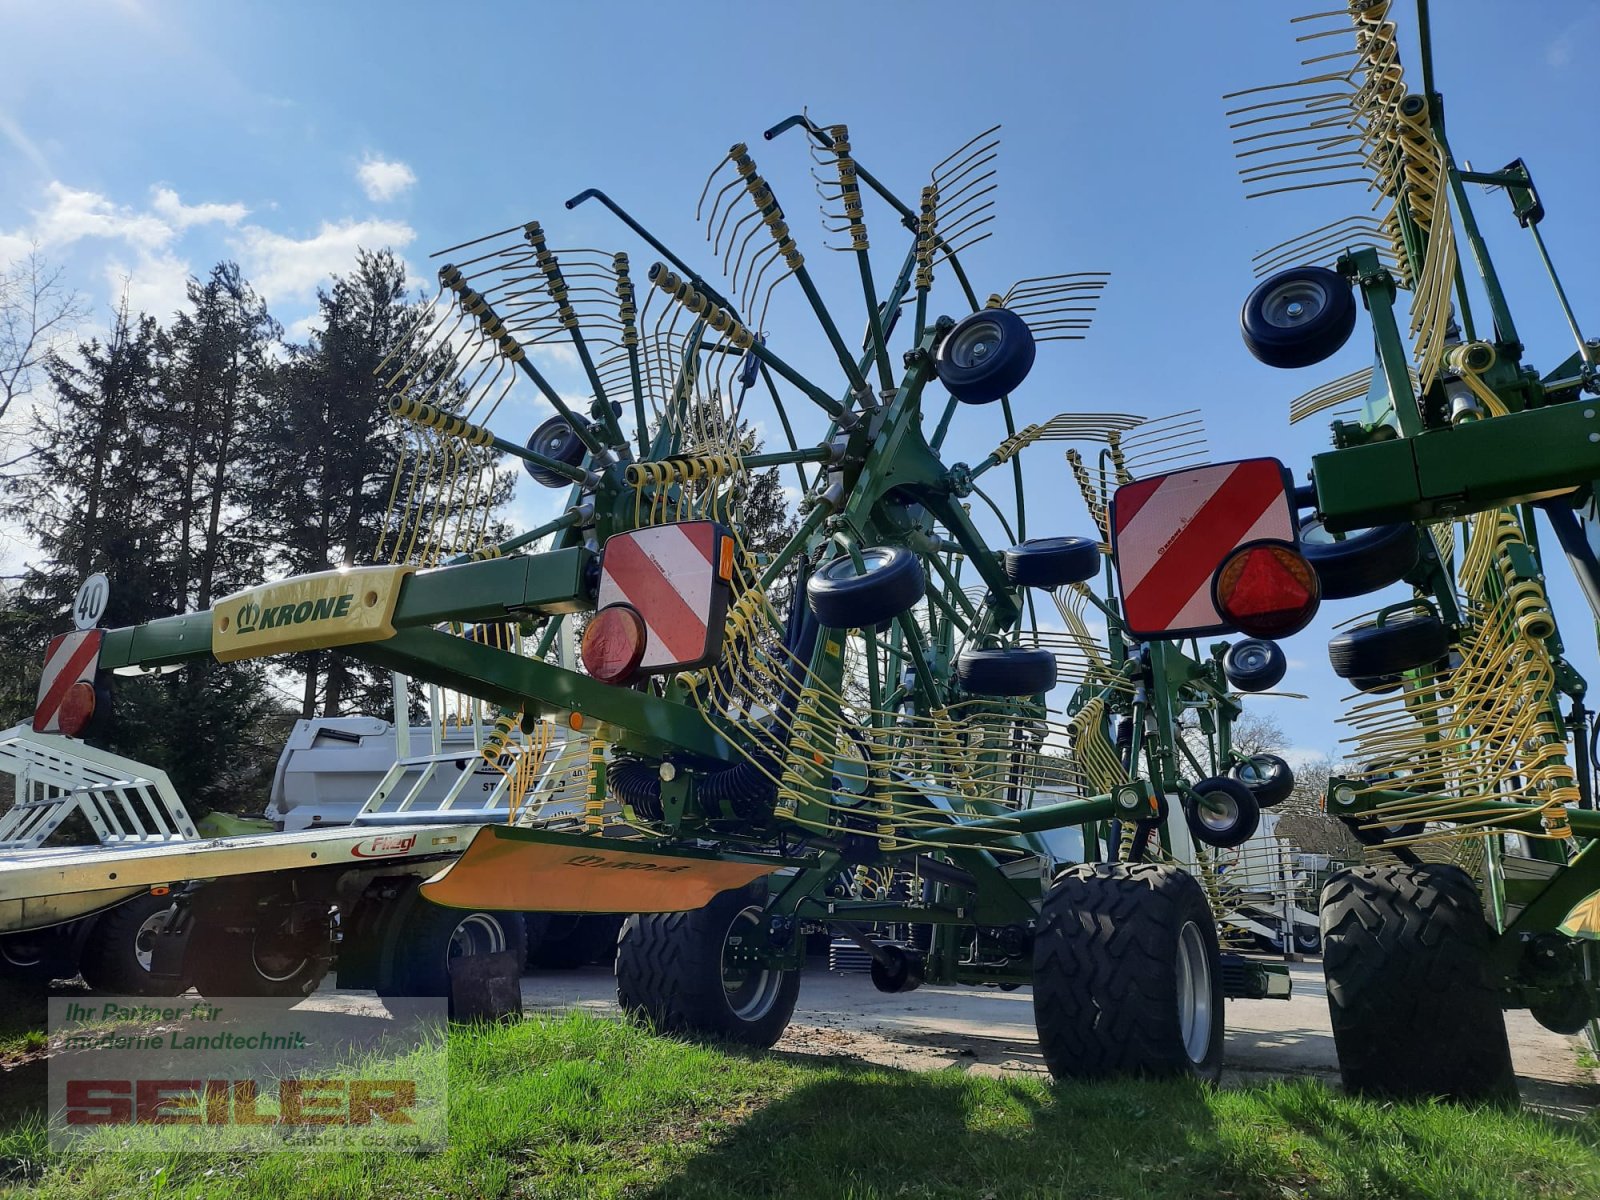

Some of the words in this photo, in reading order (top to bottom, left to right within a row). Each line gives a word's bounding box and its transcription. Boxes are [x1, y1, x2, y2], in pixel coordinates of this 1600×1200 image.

[78, 582, 101, 621] 40
[259, 594, 354, 630] KRONE
[371, 834, 417, 854] Fliegl
